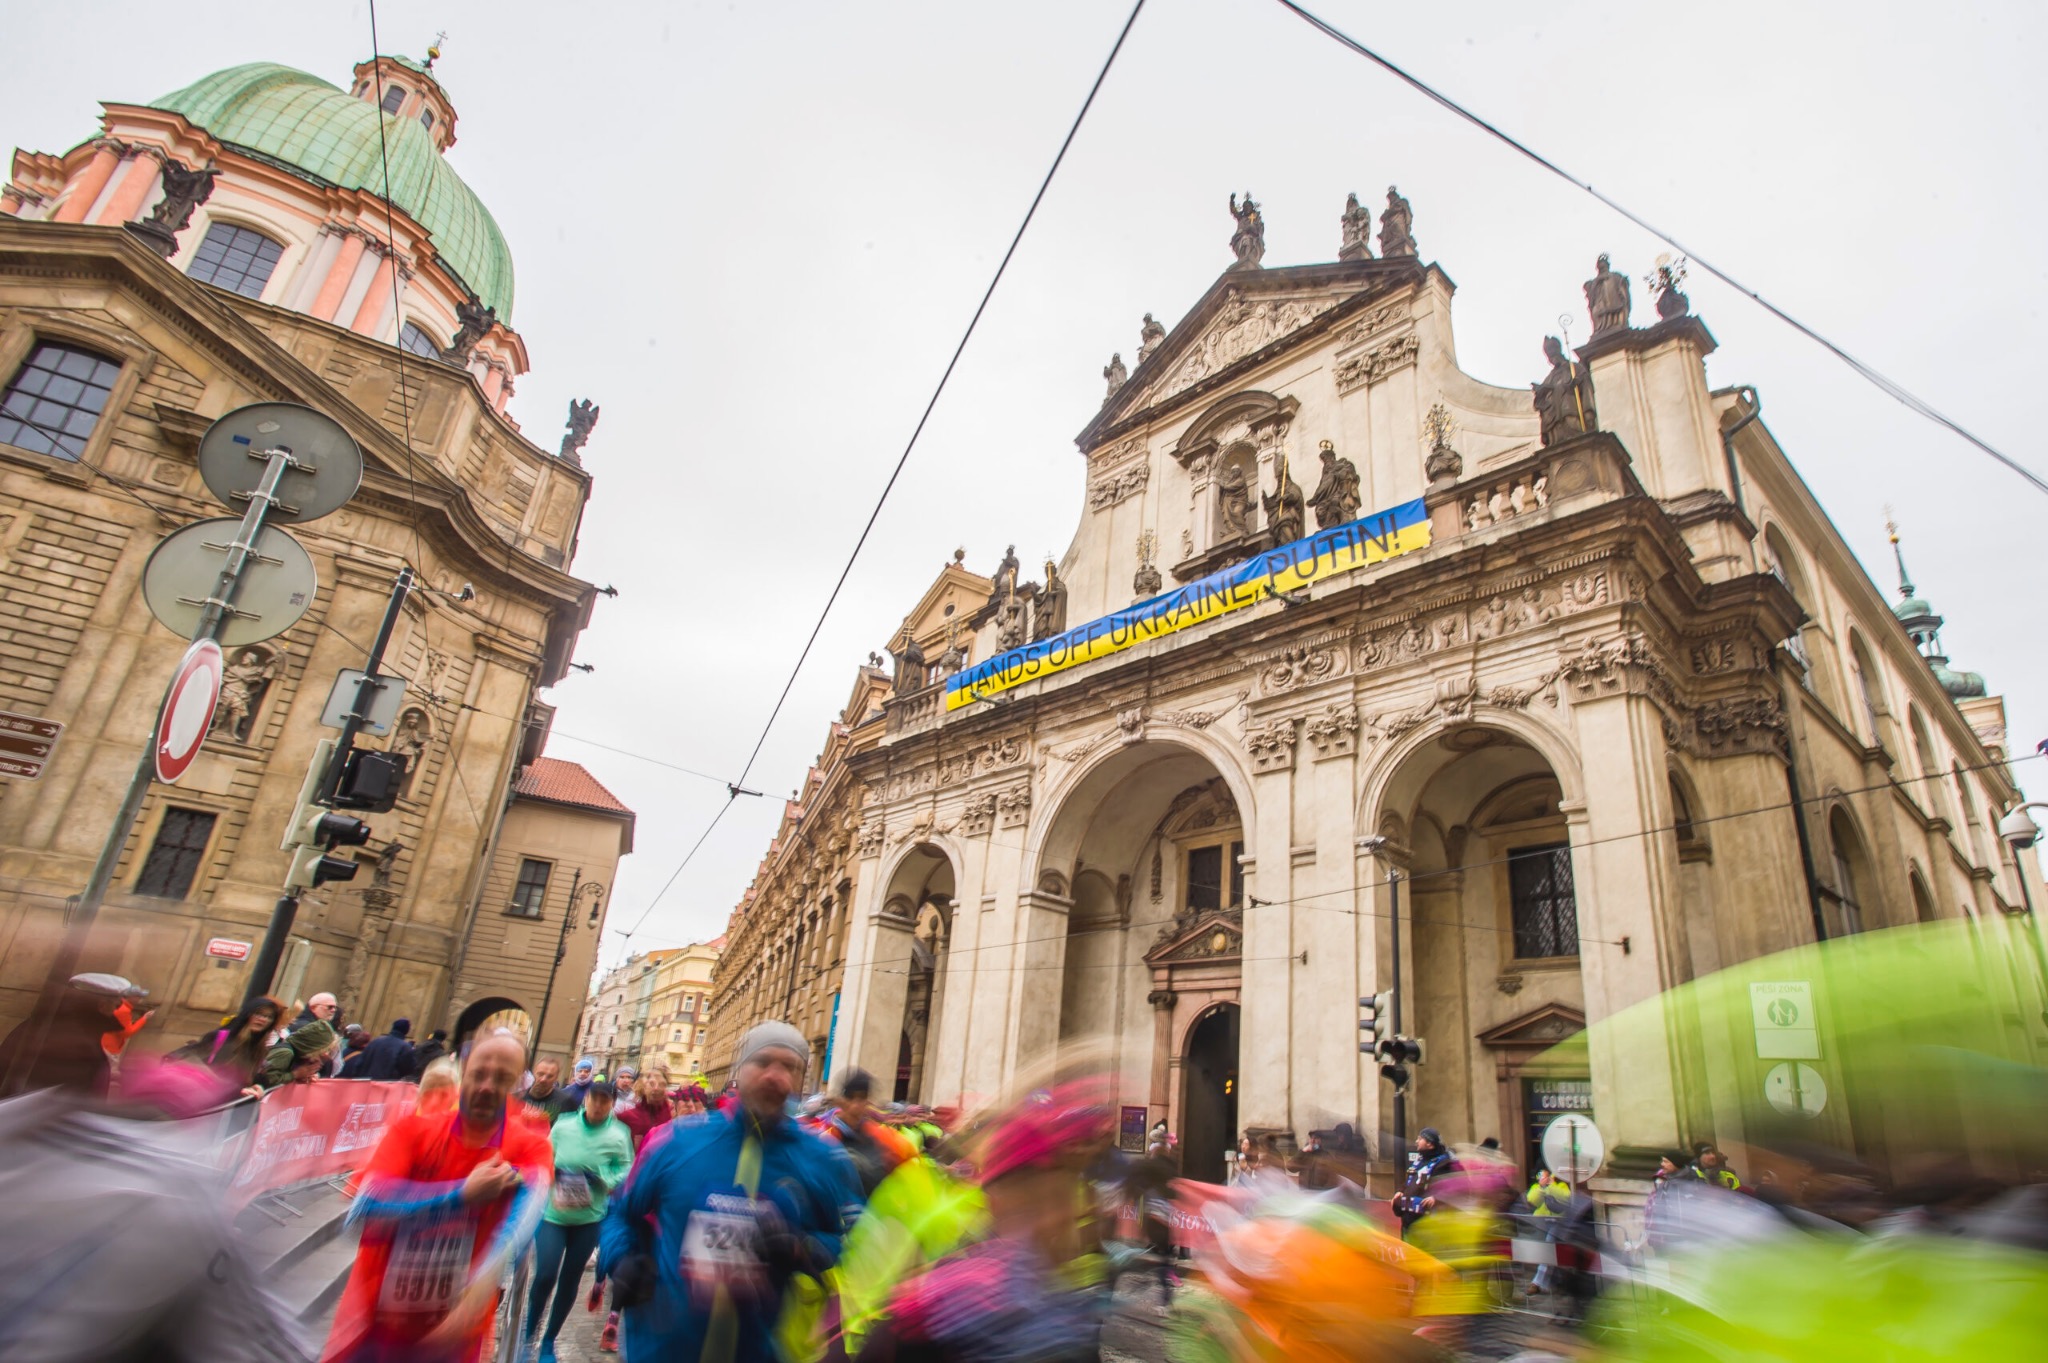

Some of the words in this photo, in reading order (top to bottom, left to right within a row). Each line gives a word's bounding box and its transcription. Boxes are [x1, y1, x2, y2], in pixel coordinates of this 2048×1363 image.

[959, 645, 1041, 701] HANDS
[1048, 622, 1102, 667] OFF
[1110, 566, 1259, 645] UKRAINE,
[1266, 513, 1400, 588] PUTIN!
